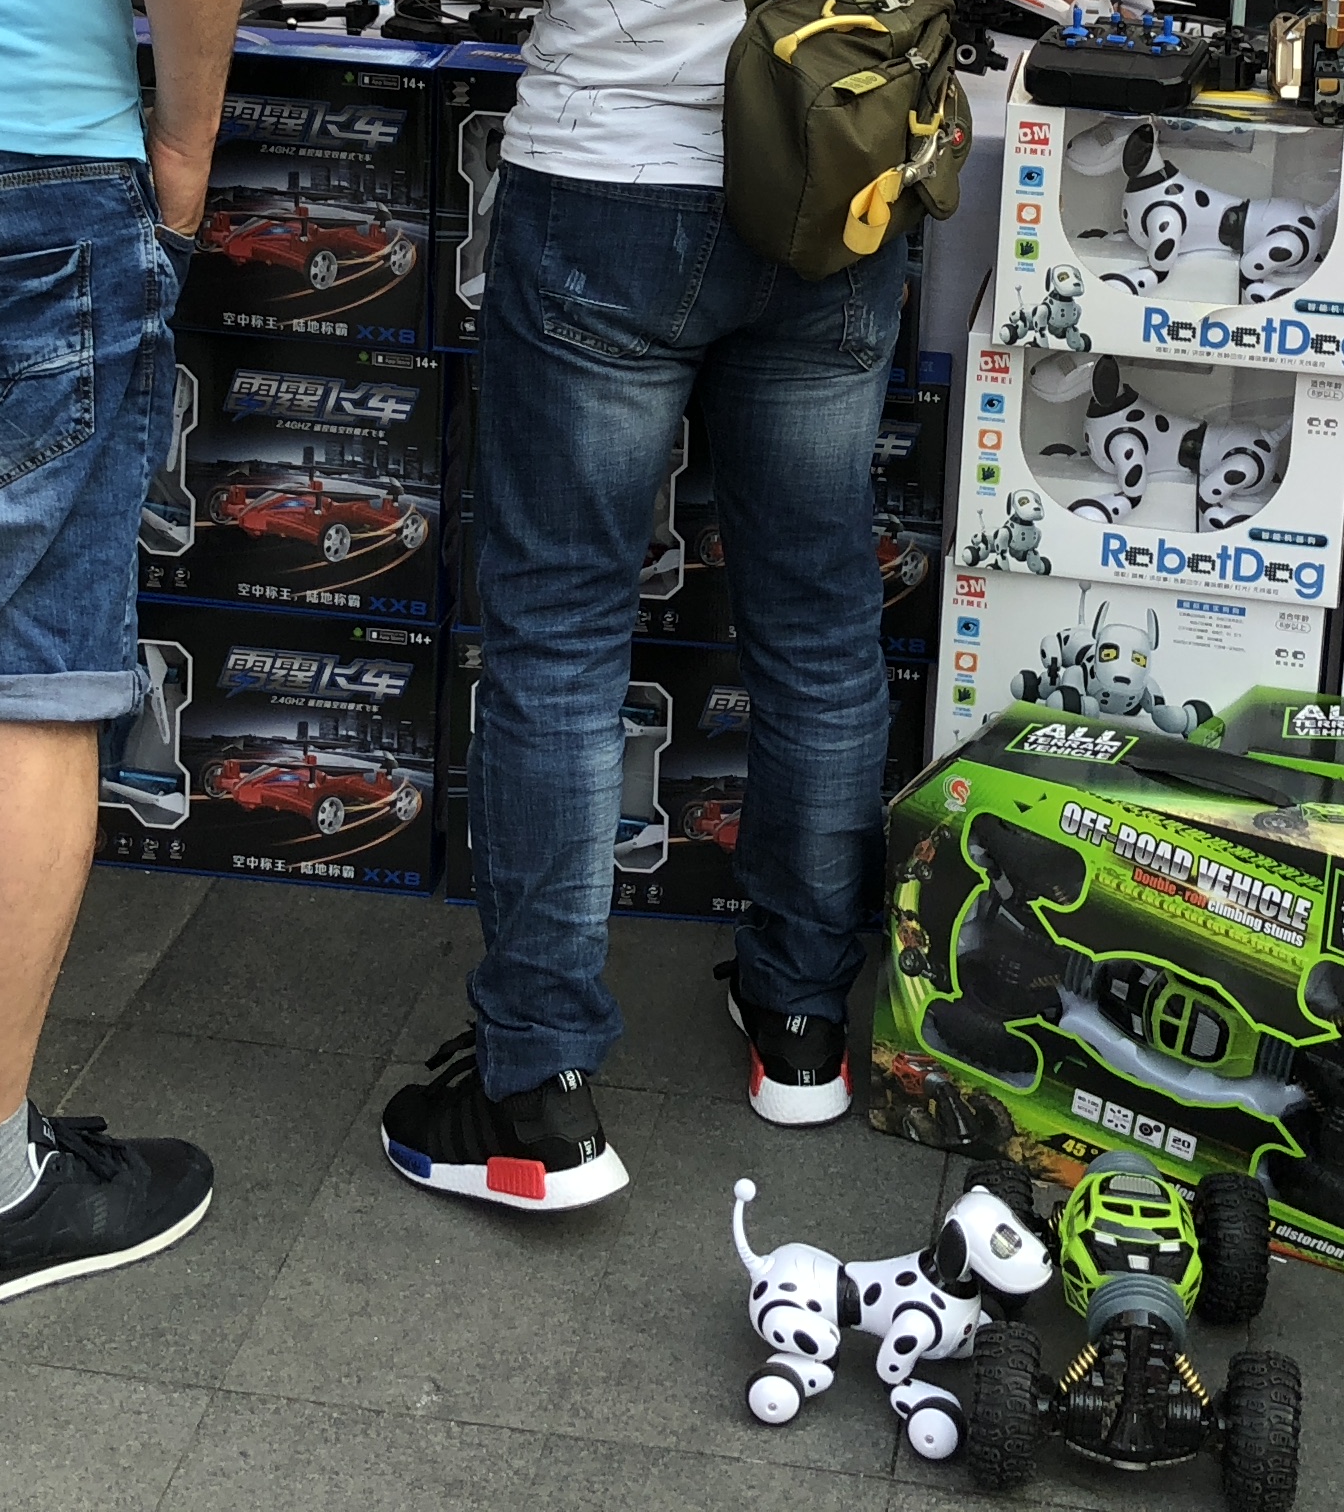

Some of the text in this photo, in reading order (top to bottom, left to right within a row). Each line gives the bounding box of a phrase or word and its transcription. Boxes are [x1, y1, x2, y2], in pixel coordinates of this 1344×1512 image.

[403, 77, 426, 90] 14+
[1014, 146, 1053, 157] DIMEI
[356, 324, 416, 344] XX8
[415, 356, 439, 369] 14+
[976, 374, 1013, 385] DIMEI
[917, 390, 941, 404] 14+
[1100, 531, 1325, 600] RobotDog
[368, 596, 427, 616] XX8
[952, 598, 989, 610] DIMEI
[409, 632, 432, 645] 14+
[897, 668, 921, 682] 14+
[1026, 734, 1123, 753] TERRAIN
[1033, 723, 1123, 747] ALL
[1022, 742, 1112, 761] VEHICLE
[362, 865, 422, 887] XX8
[1058, 801, 1312, 932] OFF-ROAD VEHICLE
[1131, 867, 1176, 898] Double
[1206, 896, 1263, 935] climbing
[1262, 921, 1305, 949] stunts
[1275, 1223, 1344, 1260] distortion
